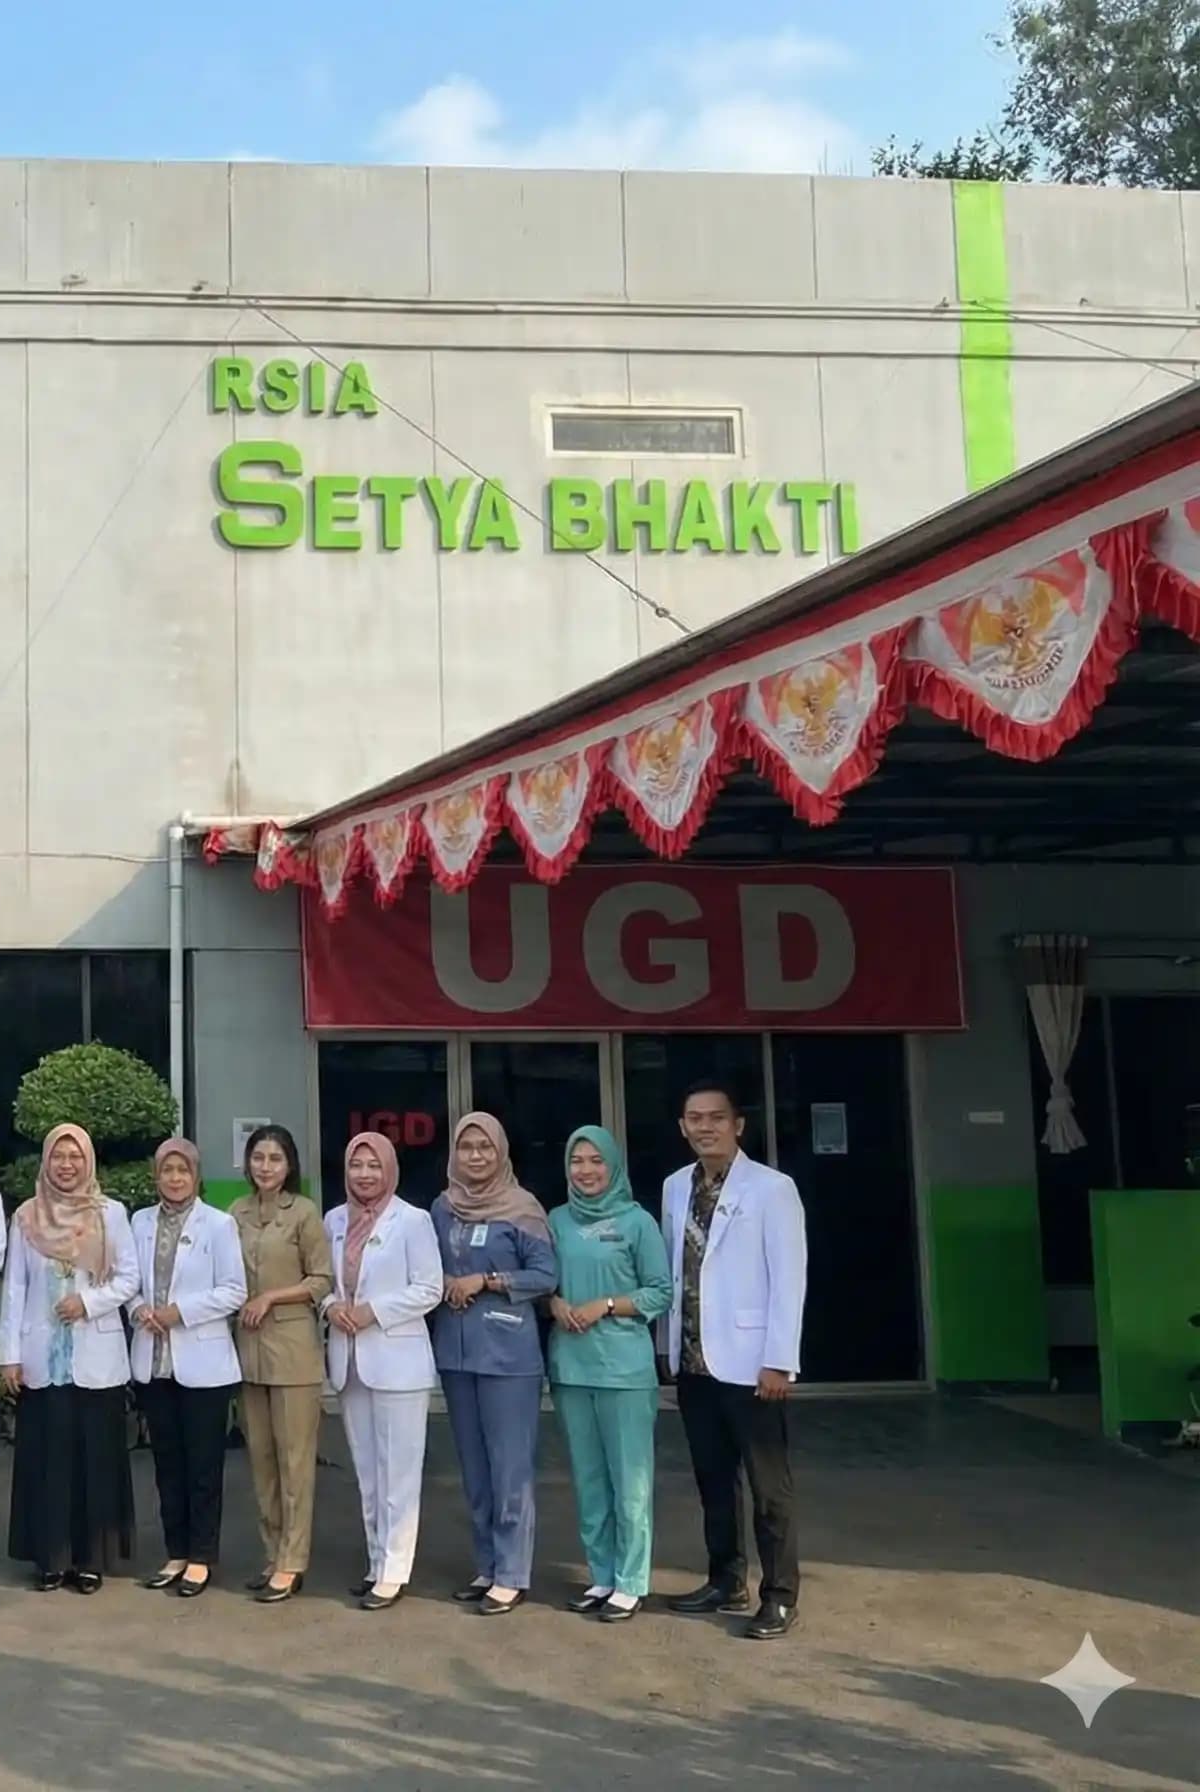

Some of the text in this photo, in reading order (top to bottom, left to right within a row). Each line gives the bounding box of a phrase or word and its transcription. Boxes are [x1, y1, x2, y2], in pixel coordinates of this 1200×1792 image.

[211, 355, 379, 417] RSIA
[216, 440, 860, 556] SETYA BHAKTI
[430, 881, 856, 1014] UGD
